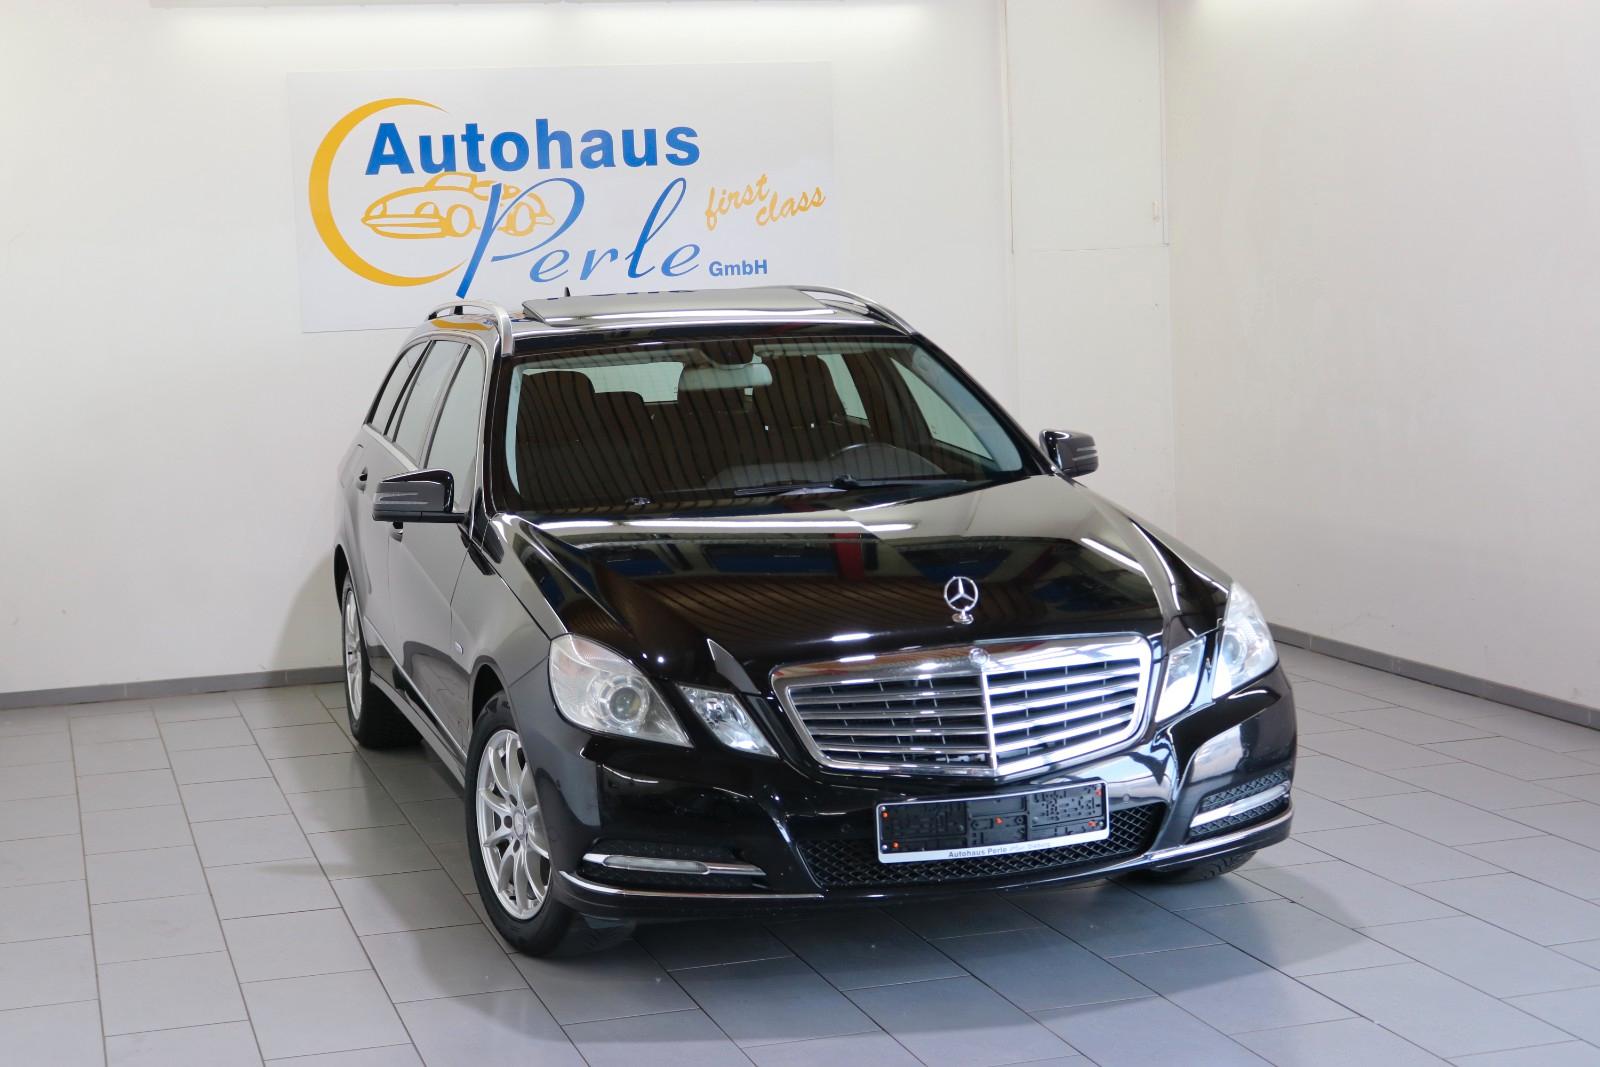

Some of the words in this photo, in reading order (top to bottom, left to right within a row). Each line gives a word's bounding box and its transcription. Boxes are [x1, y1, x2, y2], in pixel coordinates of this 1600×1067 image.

[365, 119, 701, 176] Autohaus
[704, 173, 769, 231] first
[755, 186, 826, 226] class
[455, 177, 701, 299] Perle
[708, 259, 768, 277] GmbH
[948, 848, 986, 858] Autohaus
[987, 846, 1008, 855] Perle
